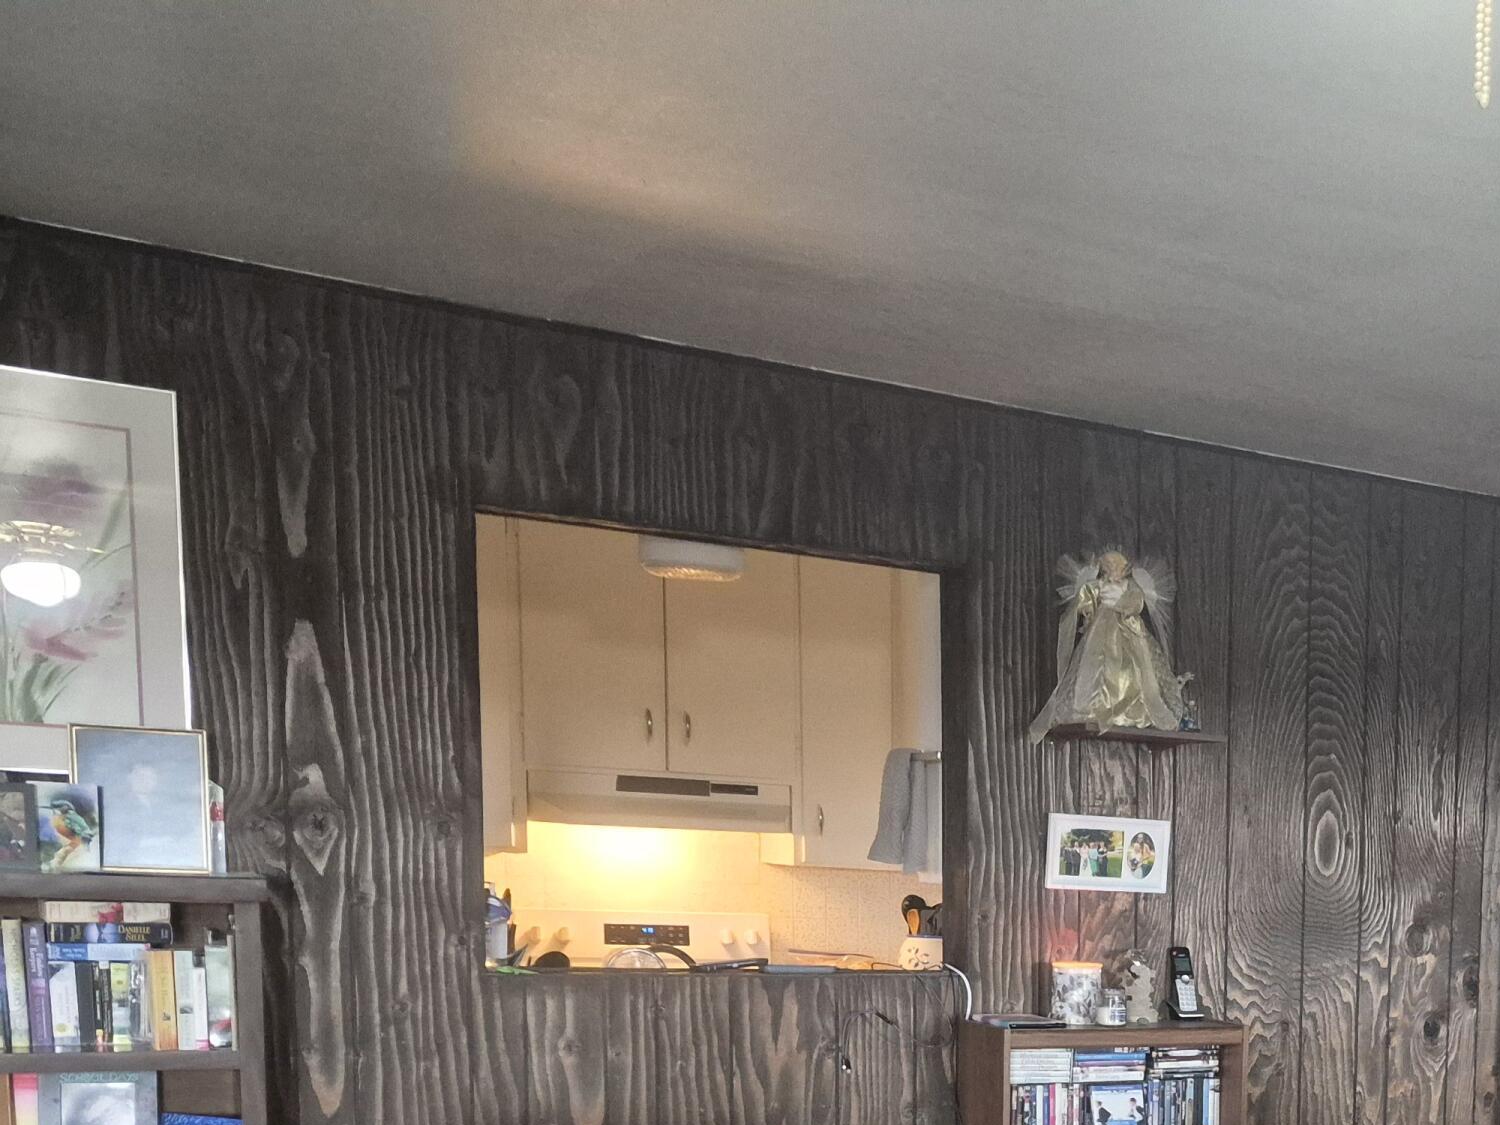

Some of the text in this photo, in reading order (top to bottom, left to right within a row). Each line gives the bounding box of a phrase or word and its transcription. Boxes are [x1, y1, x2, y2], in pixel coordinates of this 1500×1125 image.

[118, 925, 151, 934] DANIELLE
[126, 933, 145, 941] STEEL
[110, 1072, 138, 1082] DAYS
